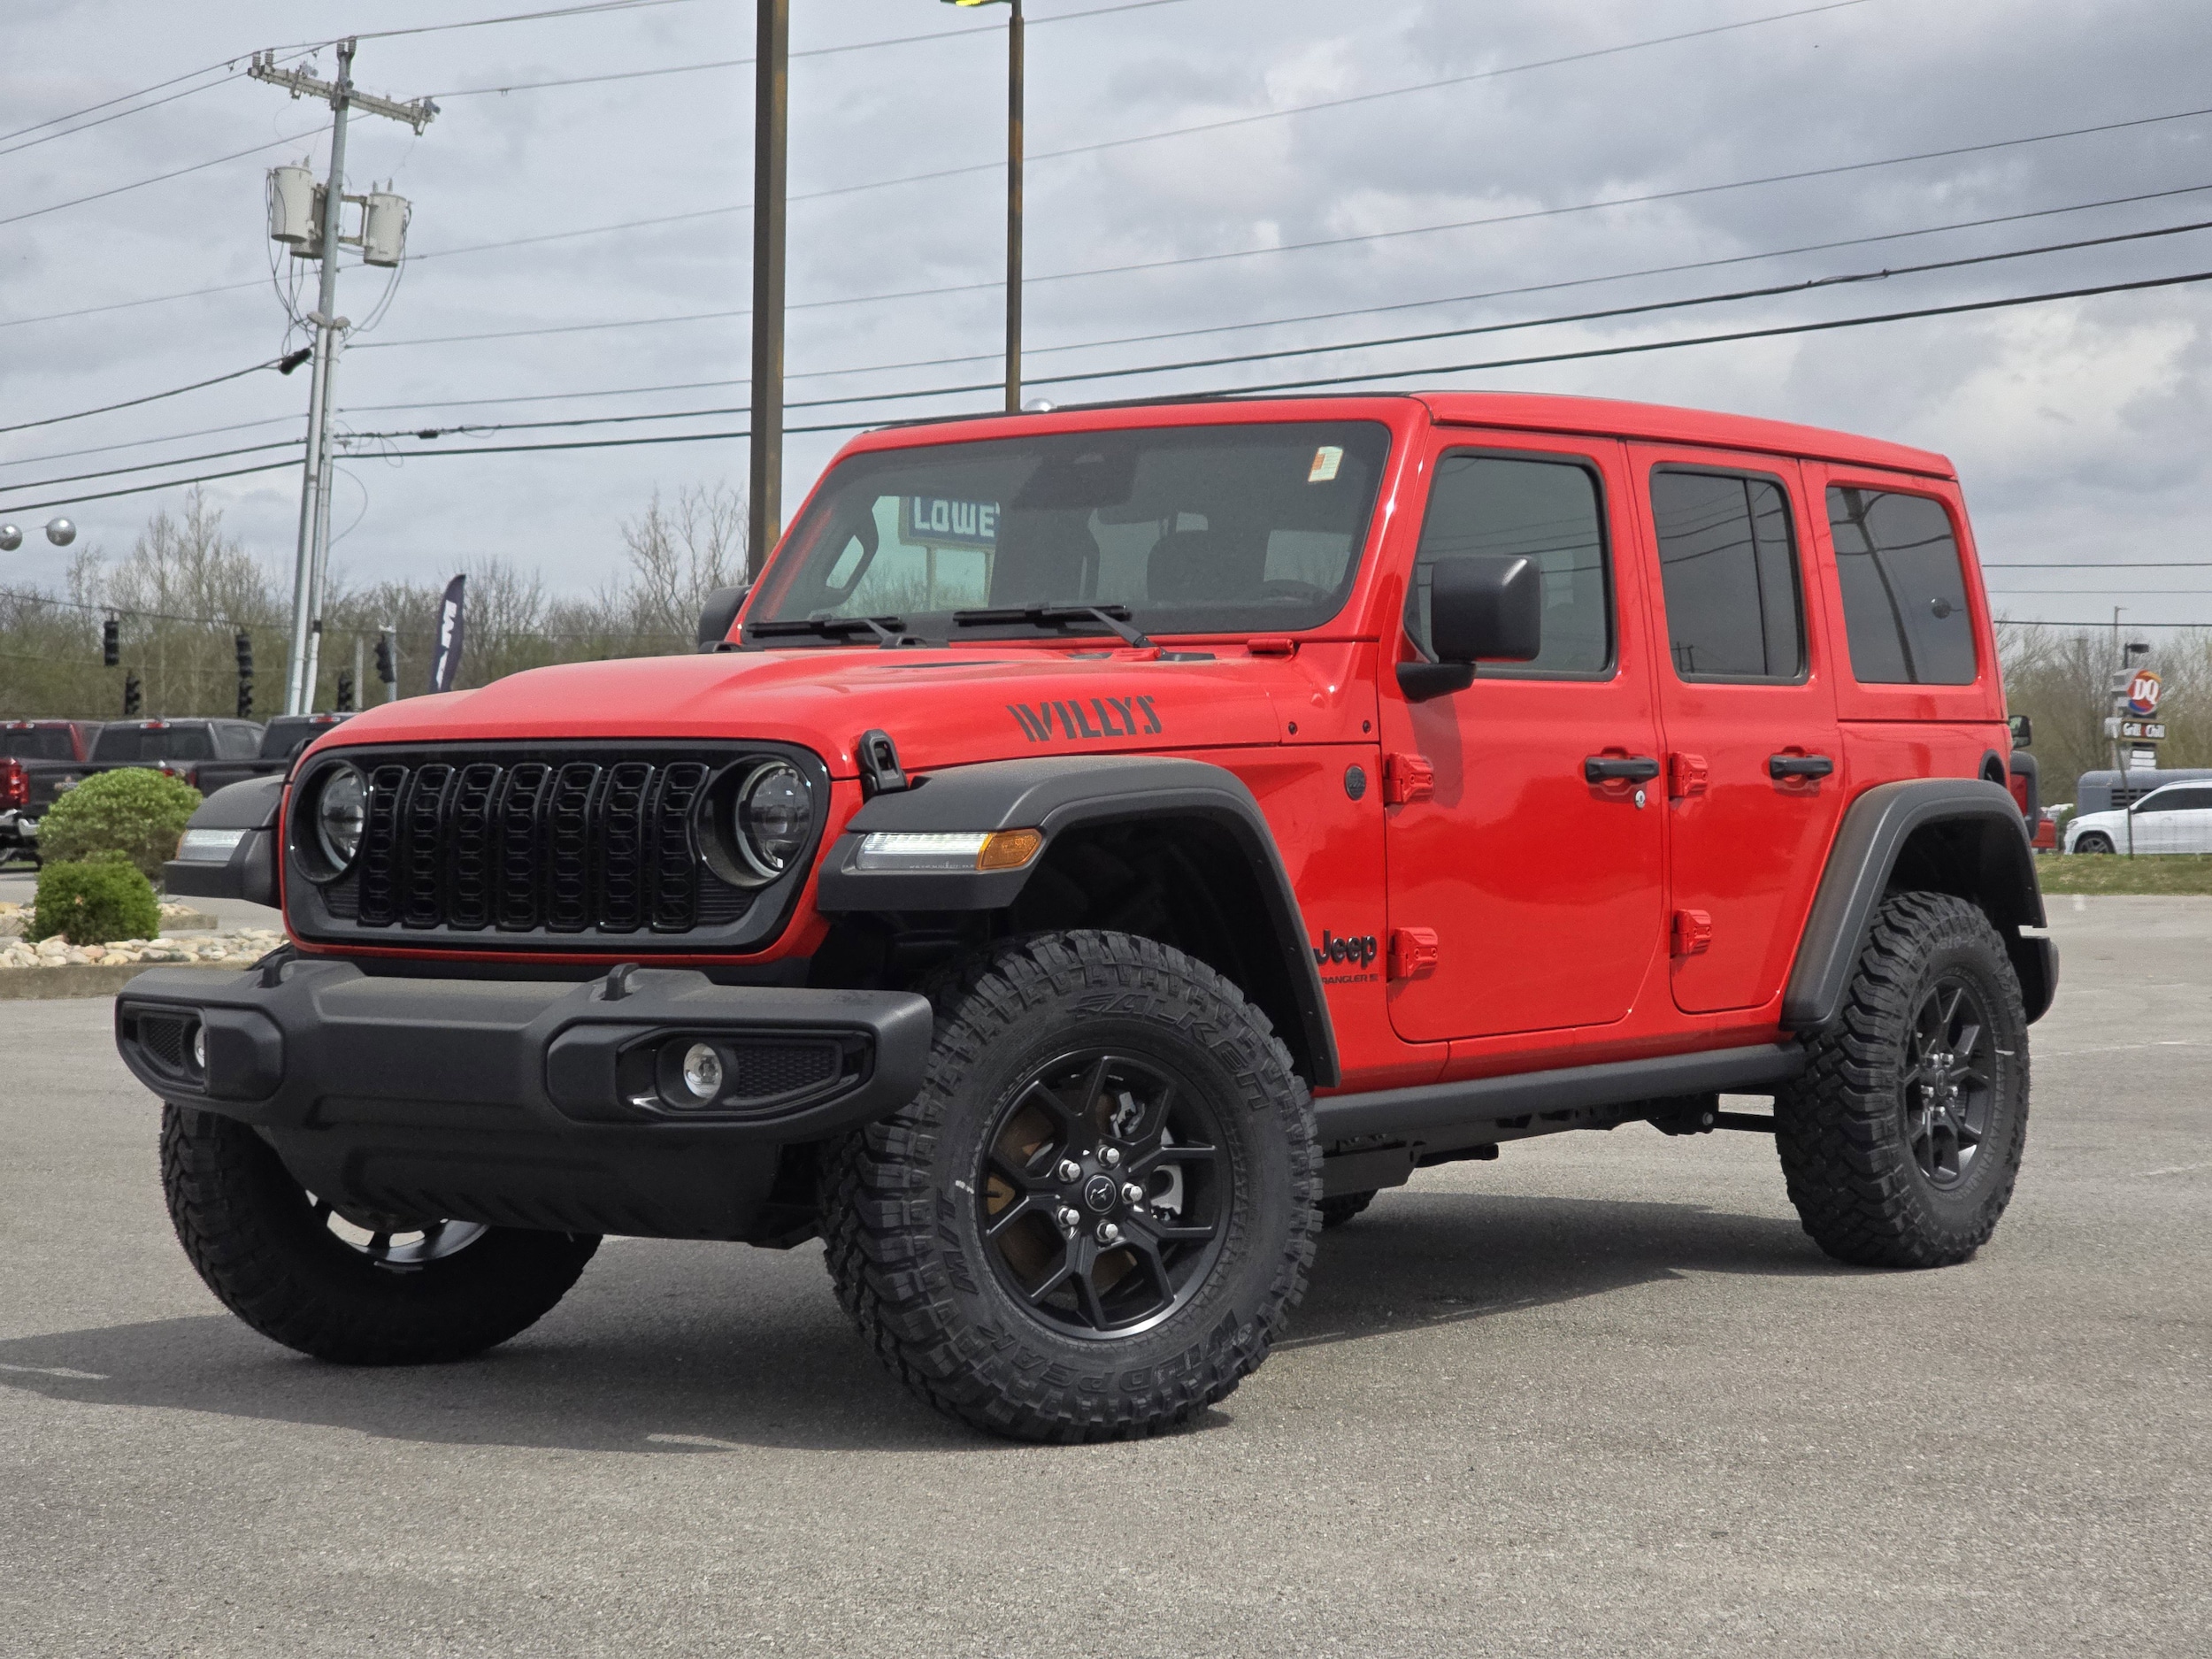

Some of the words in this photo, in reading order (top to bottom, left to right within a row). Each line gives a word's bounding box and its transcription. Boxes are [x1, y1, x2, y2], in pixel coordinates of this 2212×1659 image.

[2132, 679, 2159, 705] DQ
[1005, 695, 1162, 742] WILLYS
[1313, 930, 1377, 969] Jeep
[1321, 973, 1368, 985] RANGLER
